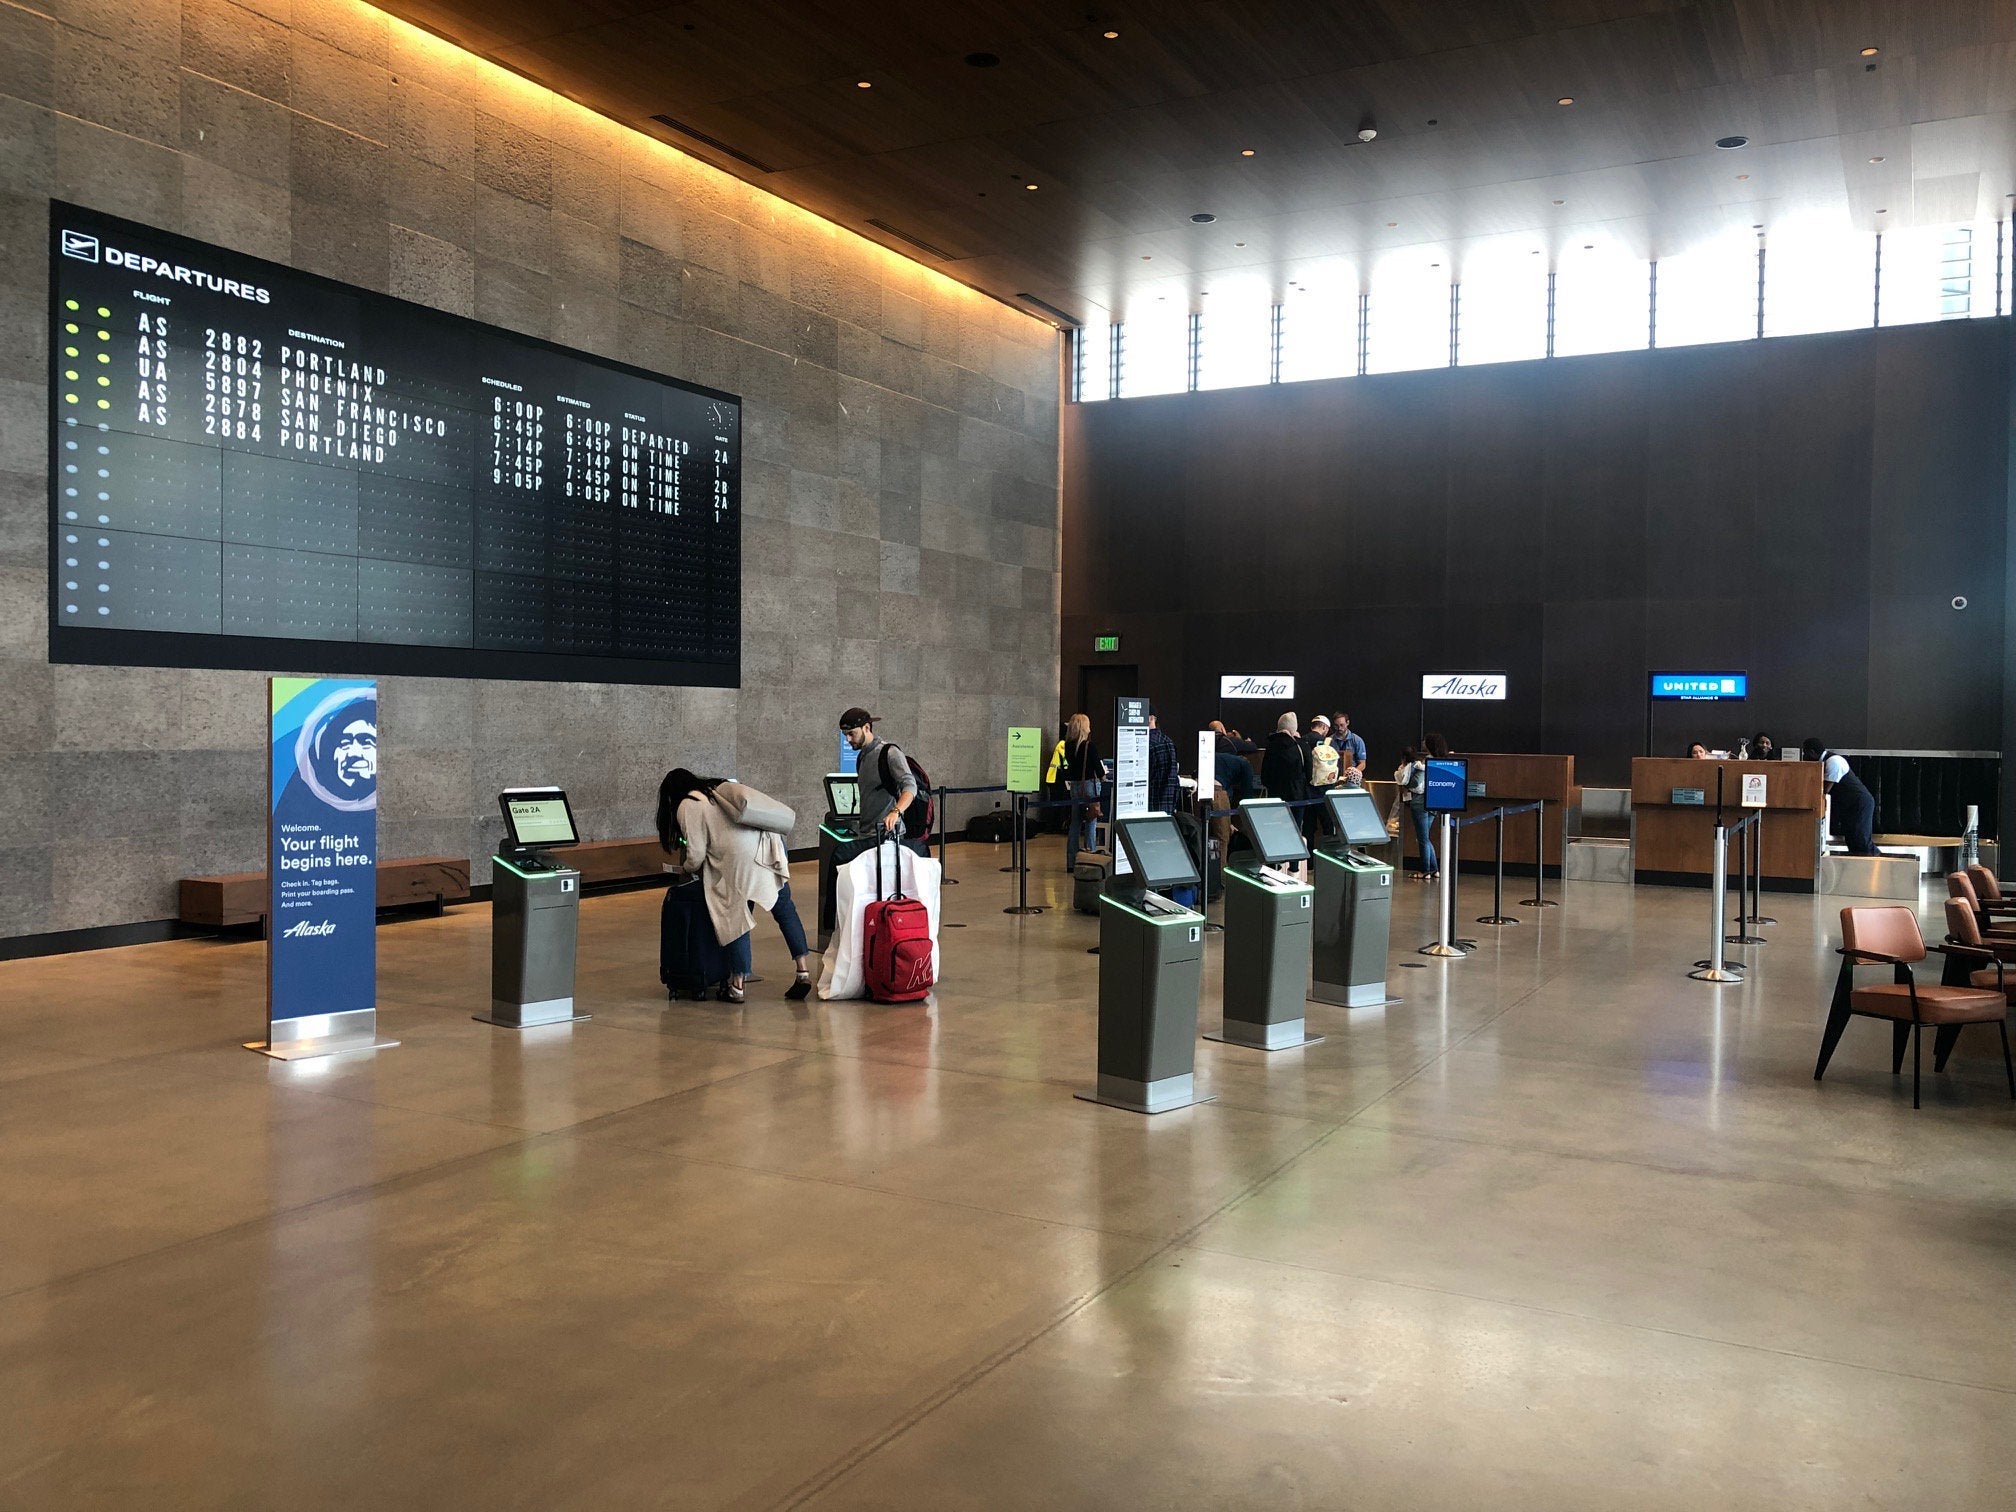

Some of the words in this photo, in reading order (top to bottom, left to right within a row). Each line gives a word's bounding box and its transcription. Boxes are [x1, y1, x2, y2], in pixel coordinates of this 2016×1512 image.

[105, 247, 270, 304] DEPARTURES
[133, 290, 171, 306] FLIGHT
[288, 329, 344, 348] DESTINATION
[482, 376, 522, 392] SCHEDULED
[556, 396, 590, 408] ESTIMATED
[624, 412, 646, 422] STATUS
[138, 312, 167, 336] AS
[206, 328, 262, 358] 2882
[282, 346, 385, 386] PORTLAND
[494, 396, 542, 421] 6:00P
[566, 414, 610, 436] 6:00P
[622, 426, 688, 455] DEPARTED
[714, 450, 728, 464] 2A
[138, 336, 167, 359] AS
[206, 350, 262, 379] 2804
[282, 367, 372, 403] PHOENIX
[494, 414, 542, 438] 6:45P
[566, 431, 610, 453] 6:45P
[622, 444, 638, 460] ON
[650, 450, 680, 469] TIME
[715, 465, 720, 478] 1
[138, 358, 167, 381] UA
[206, 372, 261, 400] 5897
[282, 388, 318, 412] SAN
[338, 400, 445, 437] FRANCISCO
[494, 432, 542, 456] 7:14P
[566, 448, 610, 470] 7:14P
[622, 460, 638, 476] ON
[650, 466, 680, 484] TIME
[714, 480, 728, 494] 2B
[138, 380, 167, 404] AS
[206, 394, 261, 421] 2678
[282, 409, 318, 432] SAN
[336, 420, 396, 446] DIEGO
[494, 450, 542, 474] 7:45P
[566, 465, 610, 486] 7:45P
[622, 476, 638, 492] ON
[650, 482, 680, 500] TIME
[714, 495, 728, 510] 2A
[138, 403, 167, 426] AS
[206, 416, 261, 442] 2884
[281, 429, 384, 463] PORTLAND
[494, 468, 542, 490] 9:05P
[566, 482, 610, 503] 9:05P
[622, 492, 638, 508] ON
[649, 498, 680, 516] TIME
[715, 510, 720, 523] 1
[1100, 638, 1116, 650] EXIT
[1228, 678, 1286, 696] Alaska
[1432, 677, 1498, 698] Alaska
[1664, 682, 1718, 690] UNITED
[281, 824, 322, 832] Welcome.
[281, 837, 316, 852] Your
[320, 834, 359, 852] flight
[281, 854, 332, 872] begins
[336, 852, 372, 866] here.
[283, 920, 336, 938] Alaska
